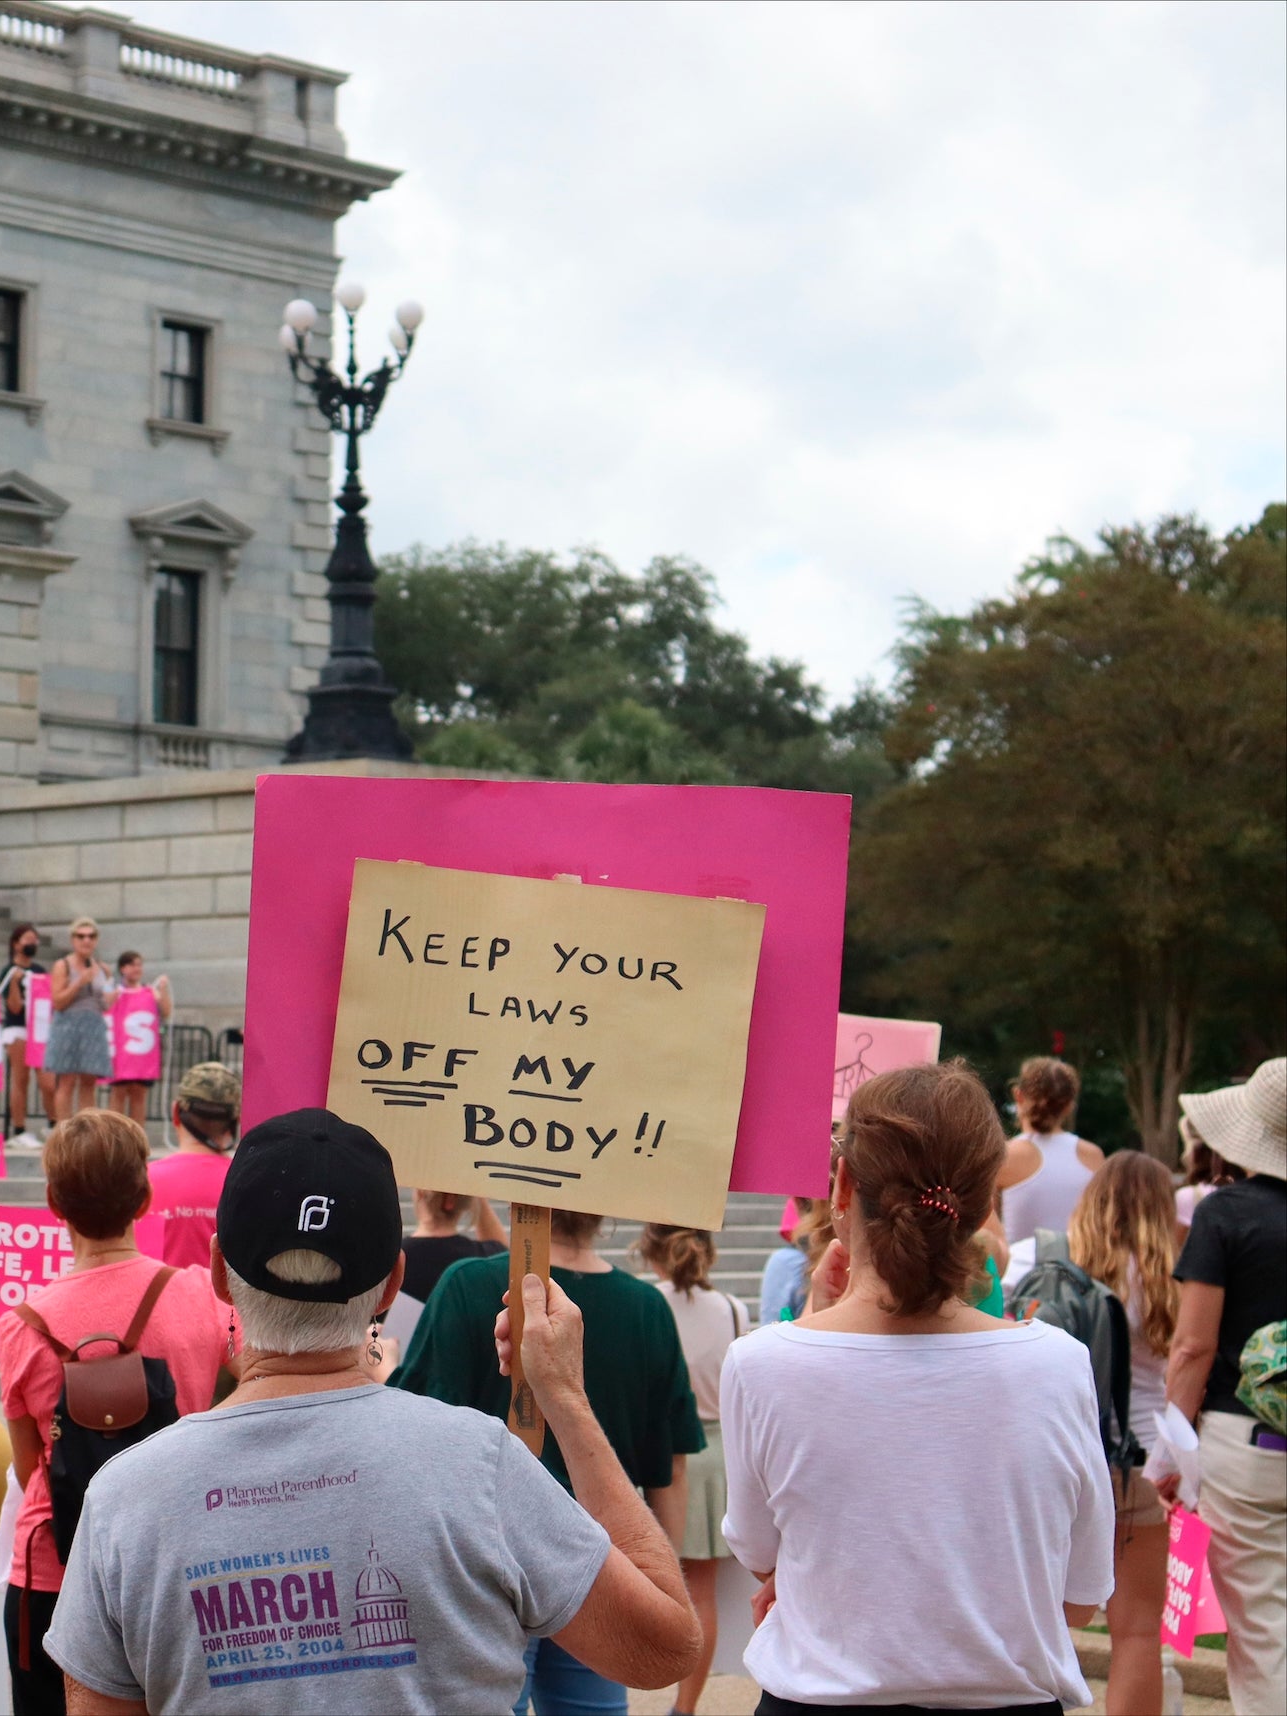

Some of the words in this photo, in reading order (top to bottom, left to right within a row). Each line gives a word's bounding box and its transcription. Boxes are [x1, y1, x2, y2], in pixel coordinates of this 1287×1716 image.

[378, 909, 510, 971] KEEP
[553, 943, 683, 990] YOUR
[469, 992, 588, 1026] LAWS
[358, 1039, 478, 1077] OFF
[512, 1054, 595, 1089] MY
[464, 1104, 666, 1159] BODY!!
[226, 1481, 278, 1501] Planned
[282, 1470, 357, 1493] Parenthood
[228, 1498, 251, 1508] Health
[186, 1563, 216, 1580] SAVE
[220, 1552, 285, 1572] WOMEN'S
[291, 1547, 330, 1563] LIVES
[190, 1571, 339, 1636] MARCH
[202, 1638, 224, 1653] FOR
[226, 1629, 276, 1651] FREEDOM
[281, 1627, 294, 1641] OF
[298, 1622, 342, 1639] CHOICE
[207, 1649, 259, 1669] APRIL
[264, 1645, 292, 1661] 25,
[298, 1639, 345, 1656] 2004
